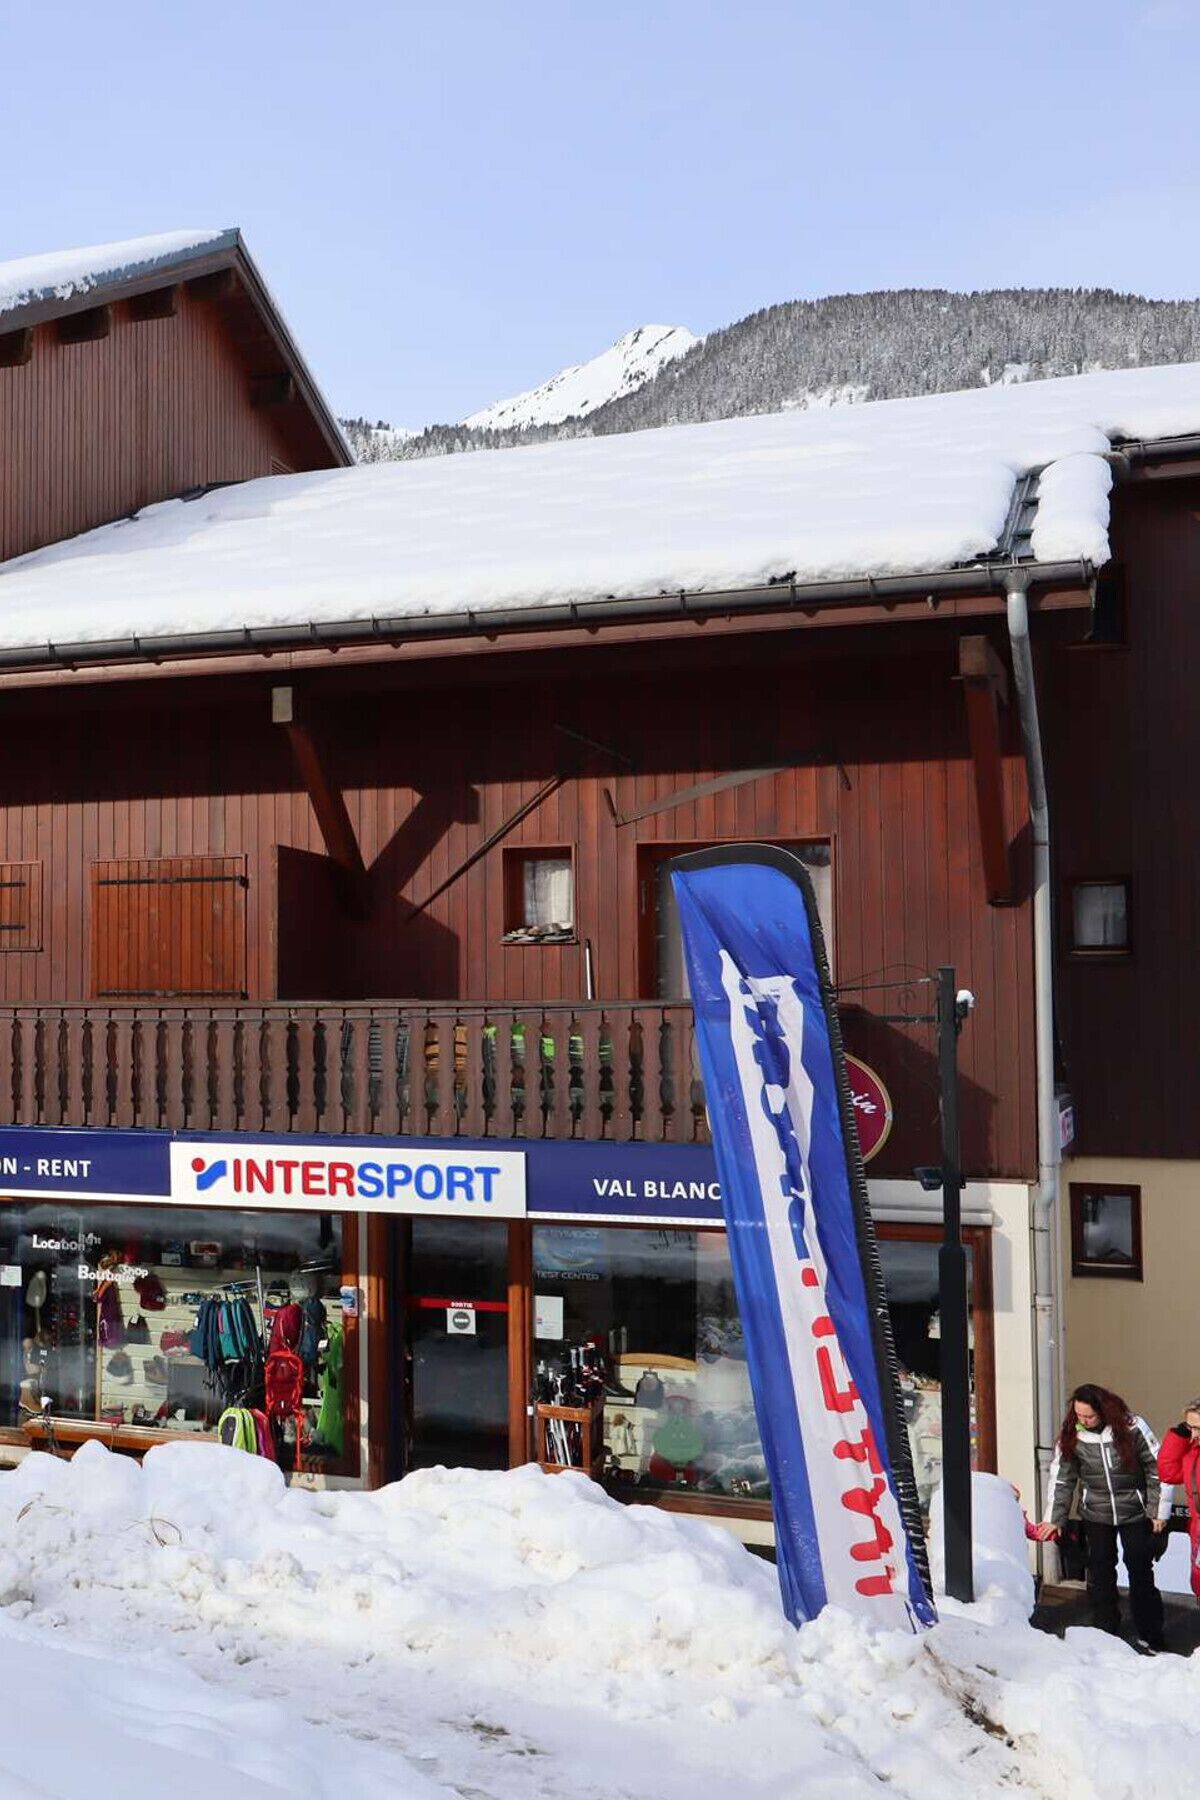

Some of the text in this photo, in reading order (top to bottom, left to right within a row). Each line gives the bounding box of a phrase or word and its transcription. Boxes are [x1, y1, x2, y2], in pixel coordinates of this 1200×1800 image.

[37, 1158, 92, 1178] RENT
[233, 1158, 501, 1202] INTERSPORT
[593, 1178, 722, 1200] VAL BLANC
[32, 1234, 86, 1251] Location
